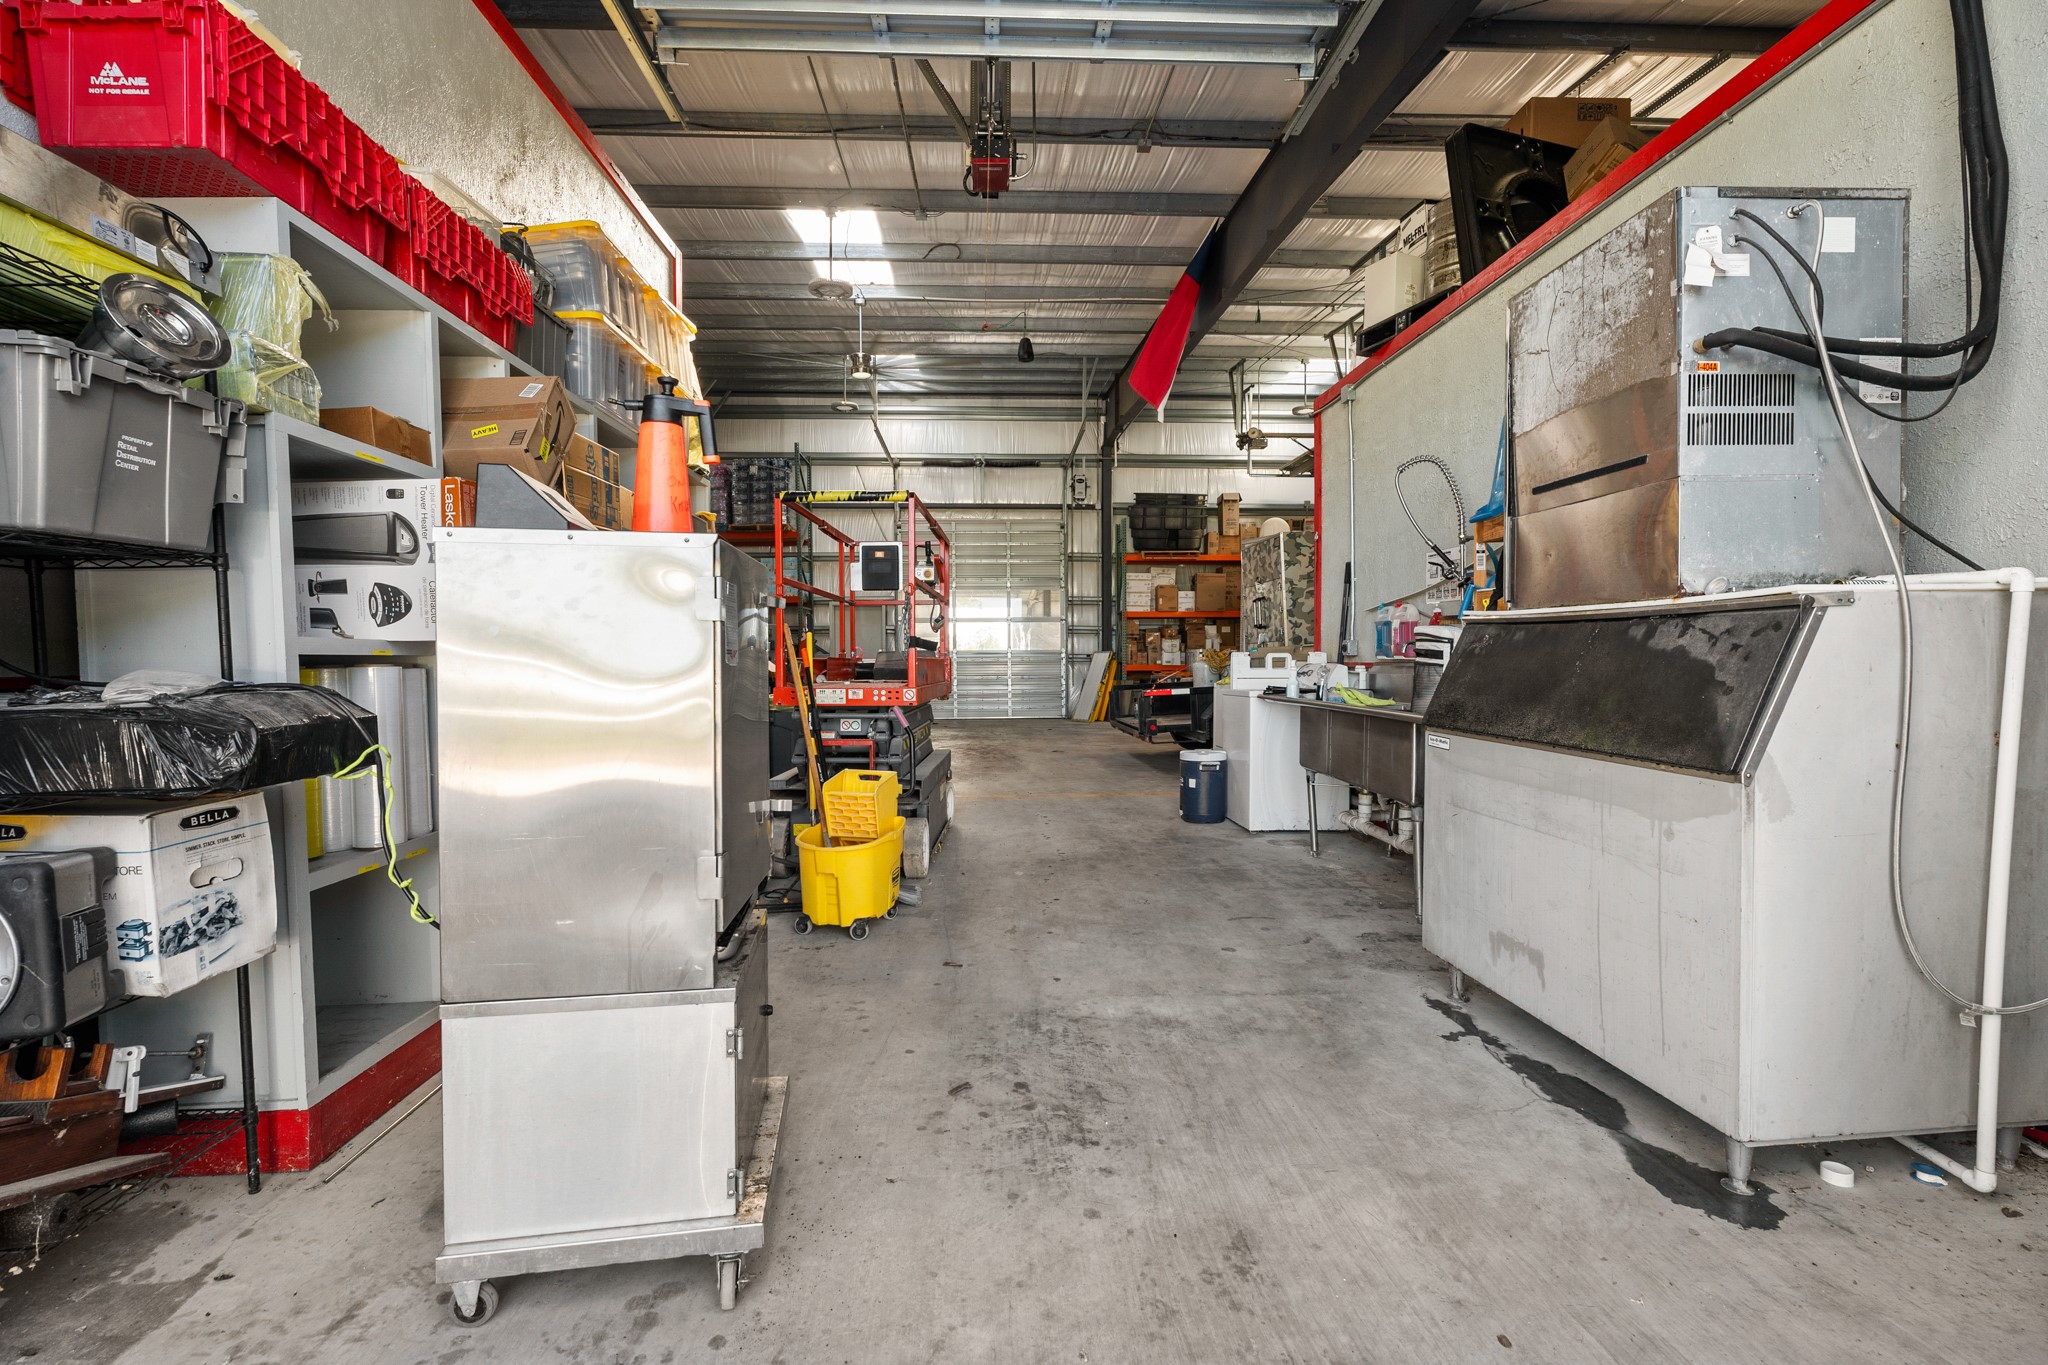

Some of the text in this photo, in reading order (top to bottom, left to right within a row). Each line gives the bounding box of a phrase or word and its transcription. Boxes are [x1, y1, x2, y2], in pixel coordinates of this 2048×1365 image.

[1403, 222, 1425, 248] MEL-FRY
[1697, 362, 1718, 371] -404A
[472, 426, 496, 436] HEAVY
[122, 435, 146, 445] PROPERTY
[420, 485, 429, 540] Tower Heater
[191, 810, 229, 826] BELLA
[115, 866, 143, 876] TORE
